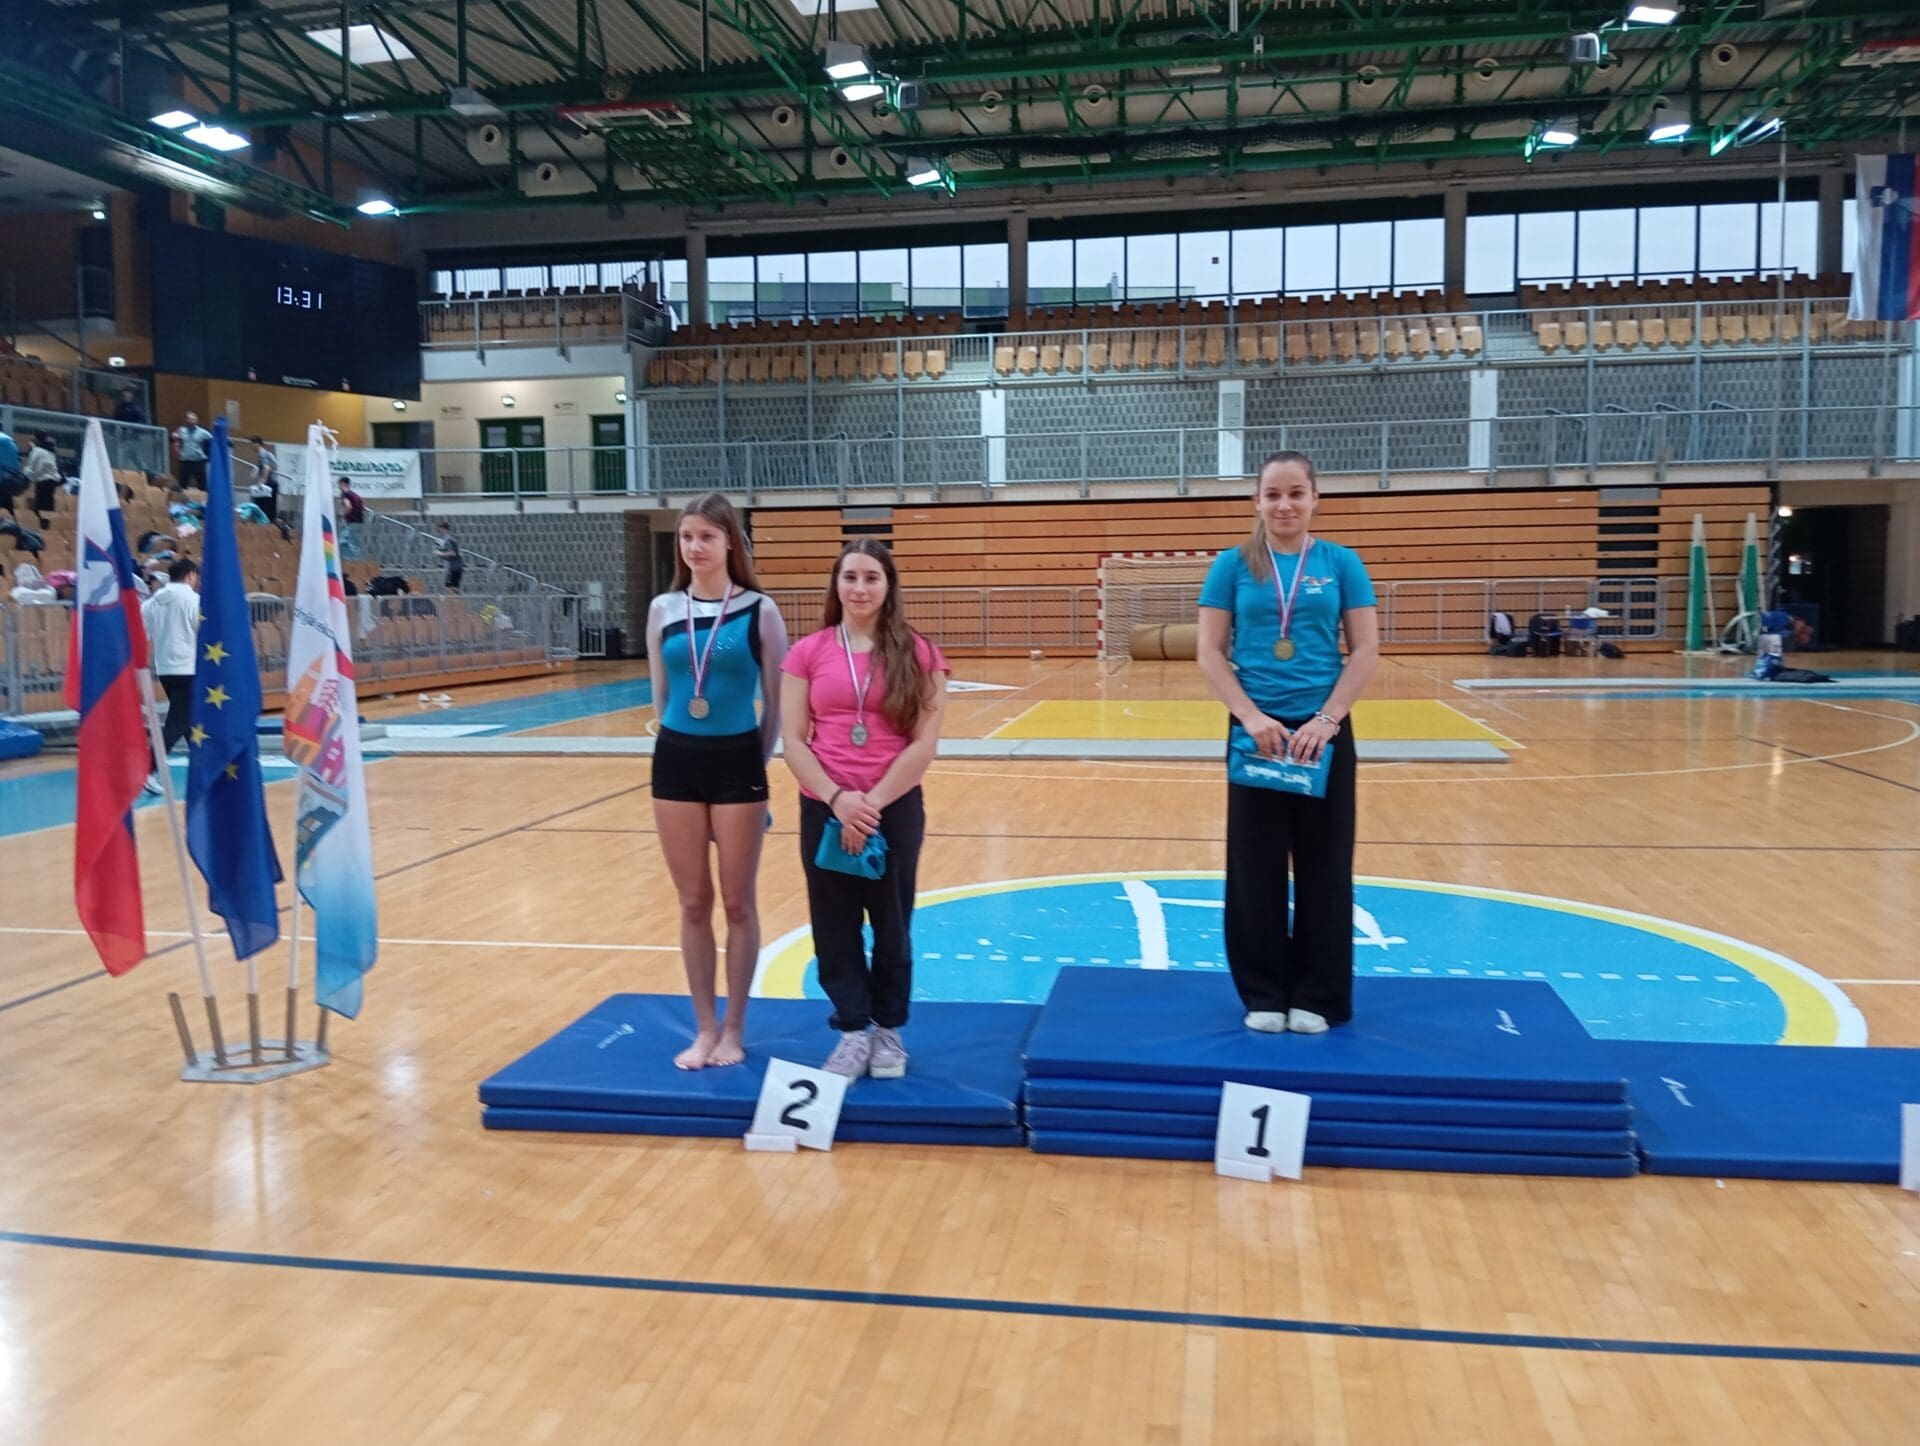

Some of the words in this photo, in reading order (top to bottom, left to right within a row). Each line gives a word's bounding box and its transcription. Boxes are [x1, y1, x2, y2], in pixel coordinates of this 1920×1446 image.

[277, 286, 322, 310] 13:31
[779, 1079, 819, 1131] 2
[1245, 1104, 1271, 1158] 1
